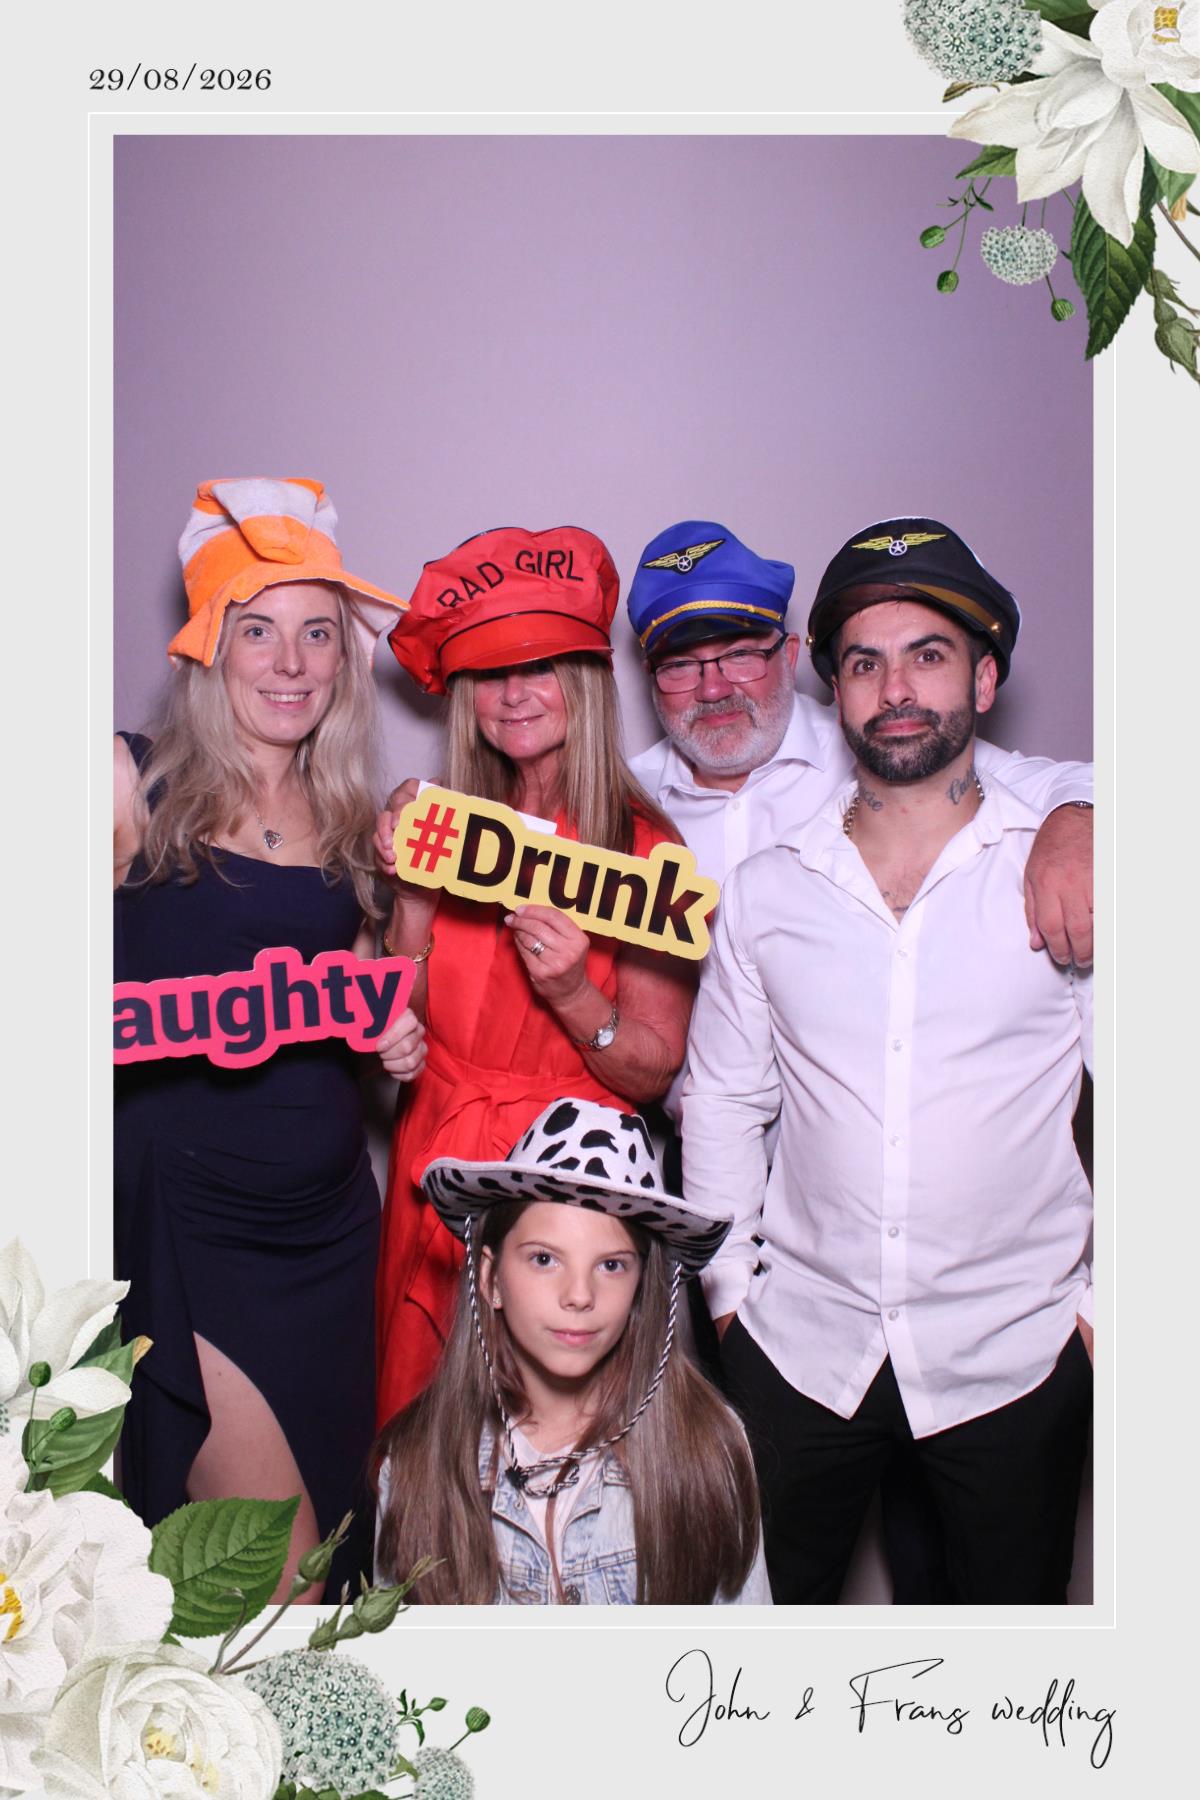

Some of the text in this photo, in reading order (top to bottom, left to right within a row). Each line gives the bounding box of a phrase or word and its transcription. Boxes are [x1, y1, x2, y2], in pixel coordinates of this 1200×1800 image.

[515, 550, 584, 582] GIRL
[406, 803, 704, 945] #Drunk
[113, 961, 402, 1055] aughty
